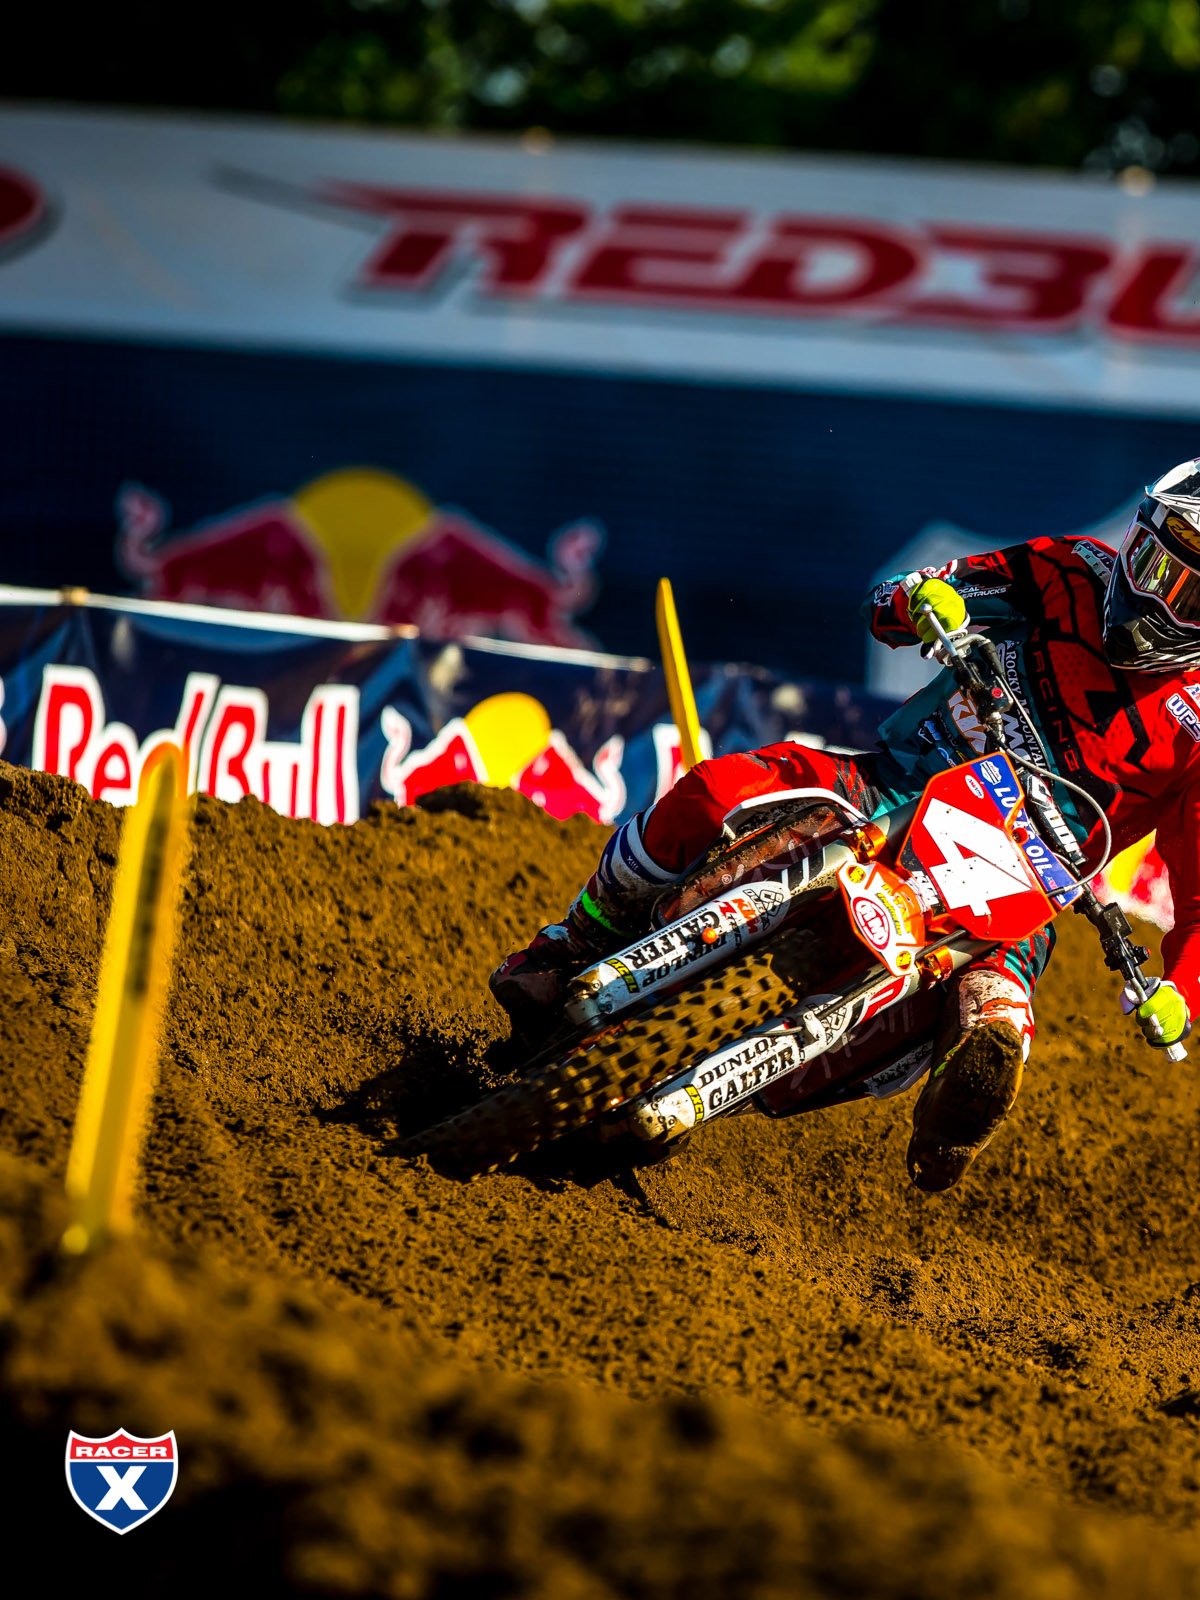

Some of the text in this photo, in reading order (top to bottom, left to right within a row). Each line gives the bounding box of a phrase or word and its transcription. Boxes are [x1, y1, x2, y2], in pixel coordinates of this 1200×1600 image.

[1005, 649, 1023, 695] ROCKY
[921, 797, 1033, 917] 4
[994, 786, 1053, 877] LUAS OIL
[624, 910, 721, 969] GALFER
[605, 957, 640, 993] EXCEL
[708, 1046, 796, 1111] GALFER
